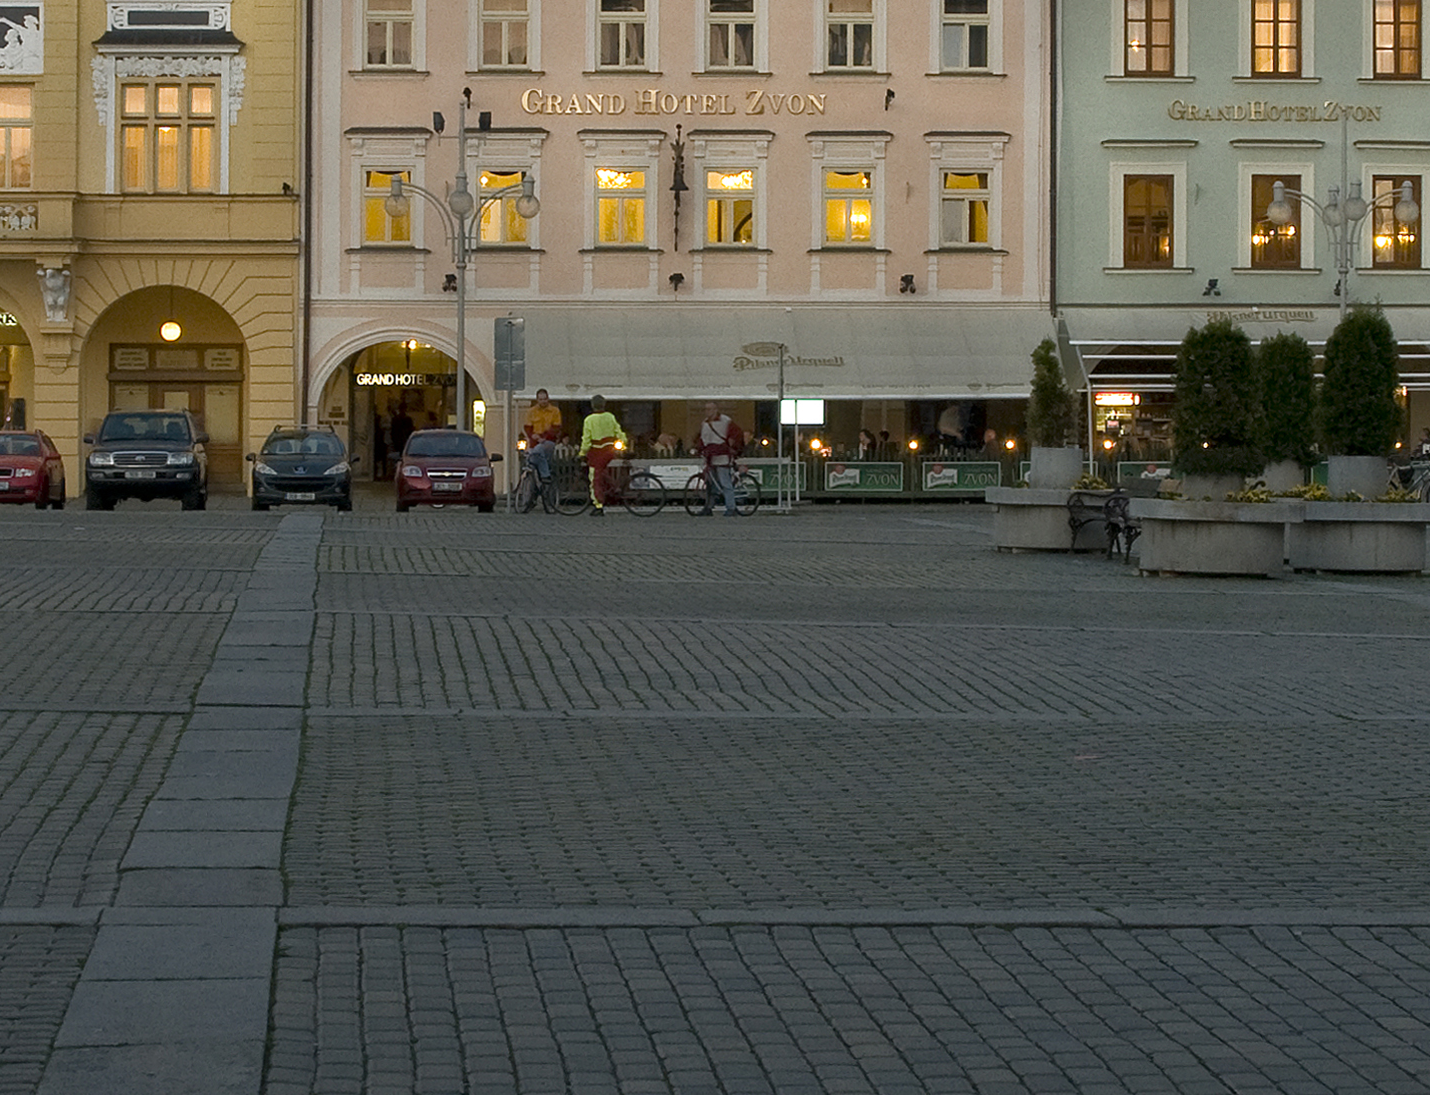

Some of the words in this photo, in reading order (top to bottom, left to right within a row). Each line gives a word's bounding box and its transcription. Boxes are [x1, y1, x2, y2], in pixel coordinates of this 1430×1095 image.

[521, 88, 625, 115] GRAND
[634, 89, 736, 115] HOTEL
[745, 89, 827, 115] ZVON
[1168, 99, 1246, 122] GRAND
[1247, 100, 1322, 122] HOTEL
[356, 373, 394, 386] GRAND
[395, 373, 429, 386] HOTEL
[866, 473, 899, 486] ZVON
[964, 473, 997, 485] ZVON
